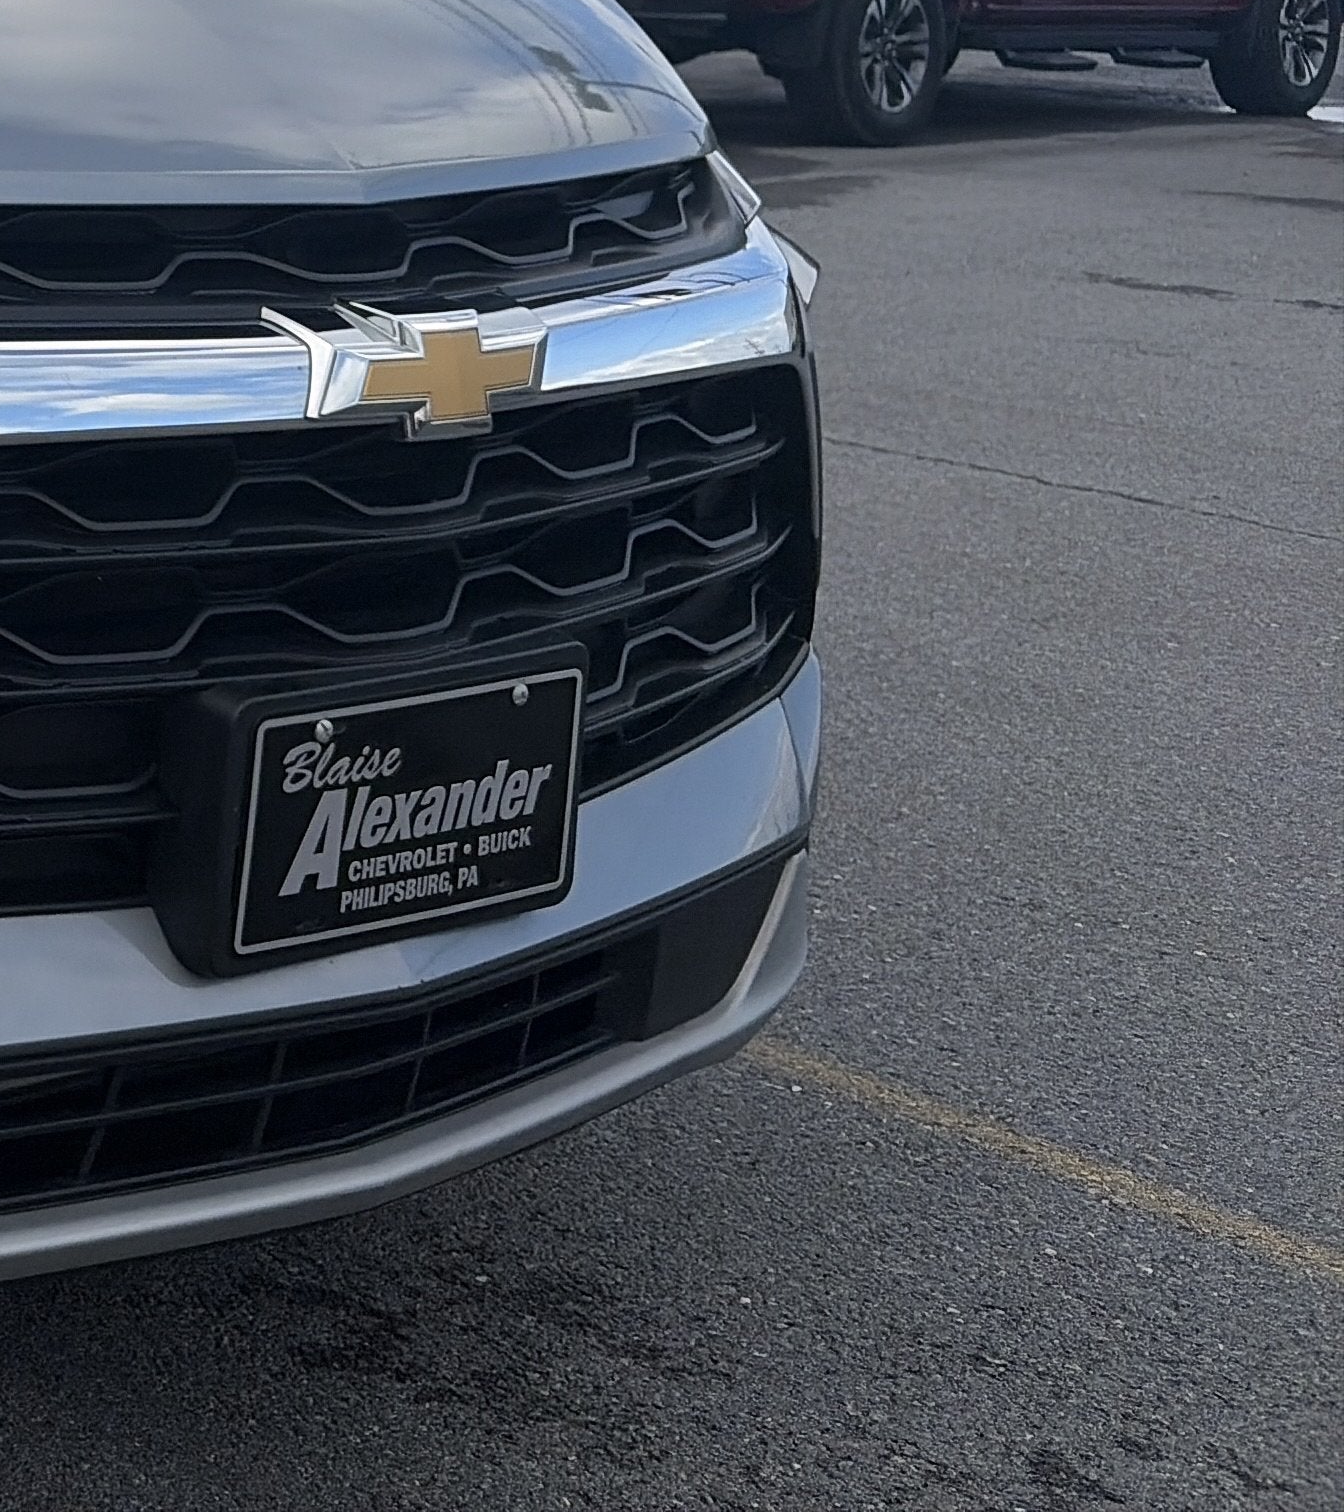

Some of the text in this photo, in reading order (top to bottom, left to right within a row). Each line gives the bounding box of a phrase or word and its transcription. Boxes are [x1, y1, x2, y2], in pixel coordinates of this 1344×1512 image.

[282, 741, 402, 794] Blaise
[278, 759, 553, 897] Alexander
[348, 825, 532, 882] CHEVROLET BUICK
[339, 865, 479, 914] PHILIPSBURG, PA
